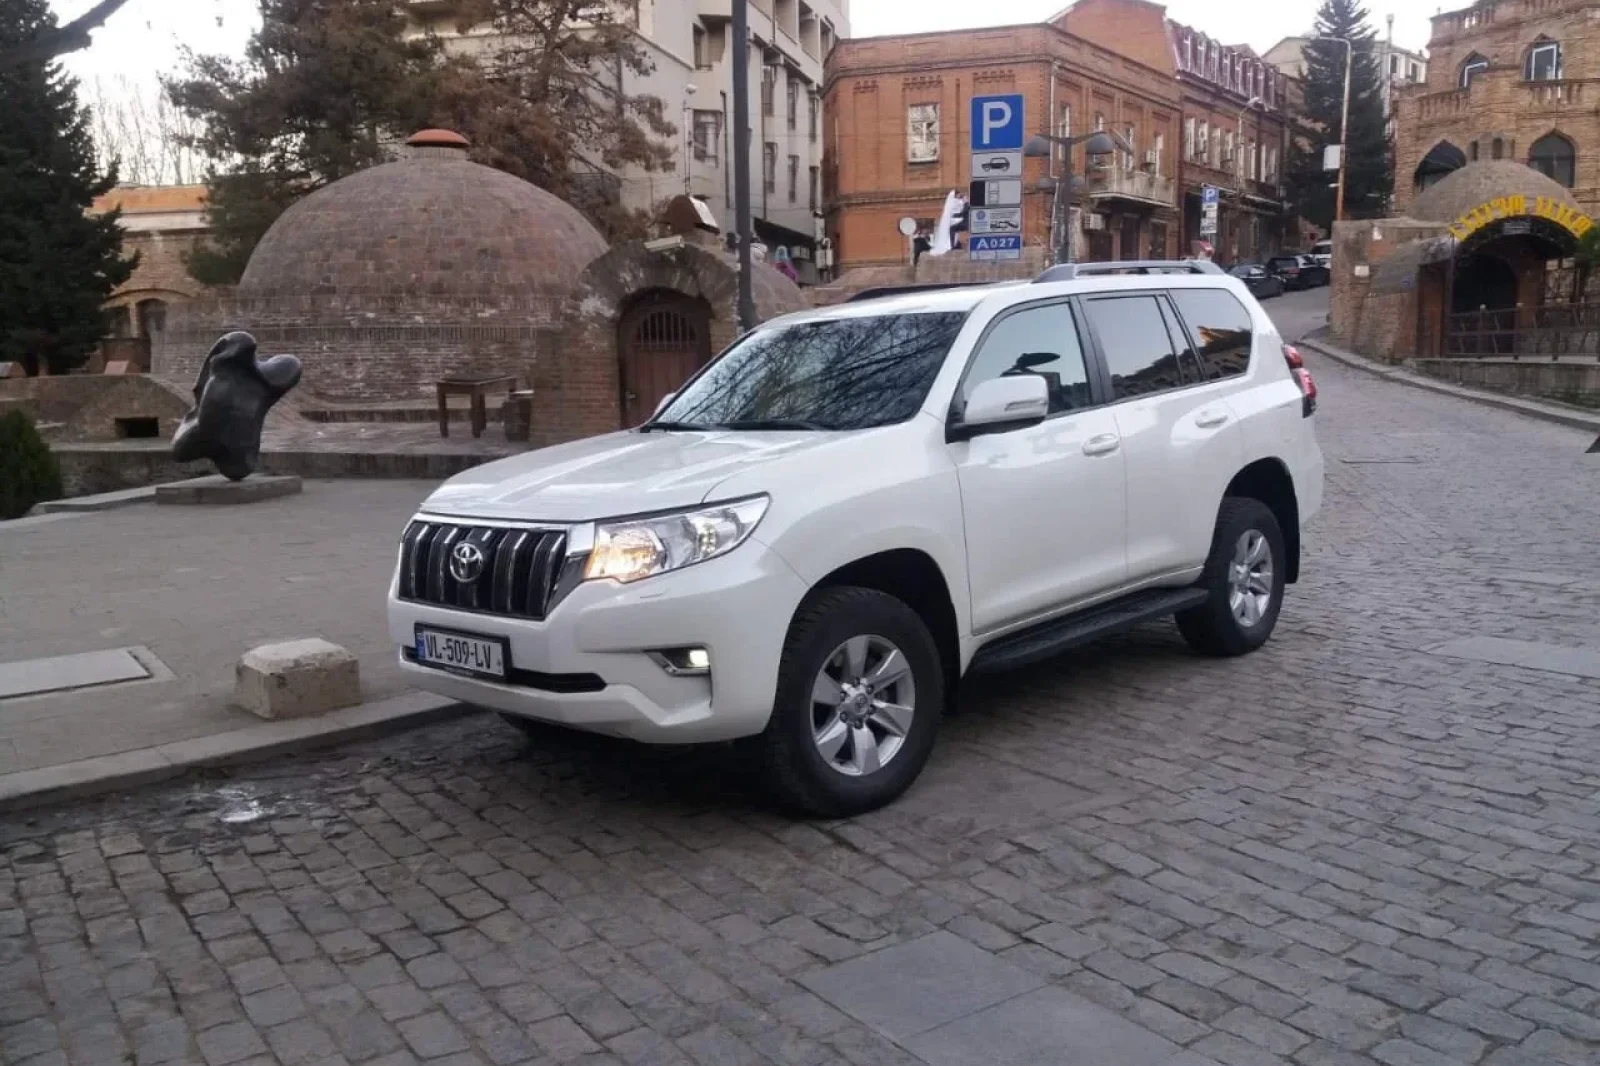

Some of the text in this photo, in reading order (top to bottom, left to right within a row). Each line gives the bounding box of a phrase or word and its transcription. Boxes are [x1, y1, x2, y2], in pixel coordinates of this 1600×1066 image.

[982, 101, 1012, 144] P
[1205, 188, 1216, 202] P
[976, 237, 1016, 250] A027
[425, 634, 491, 669] VL-509-LV
